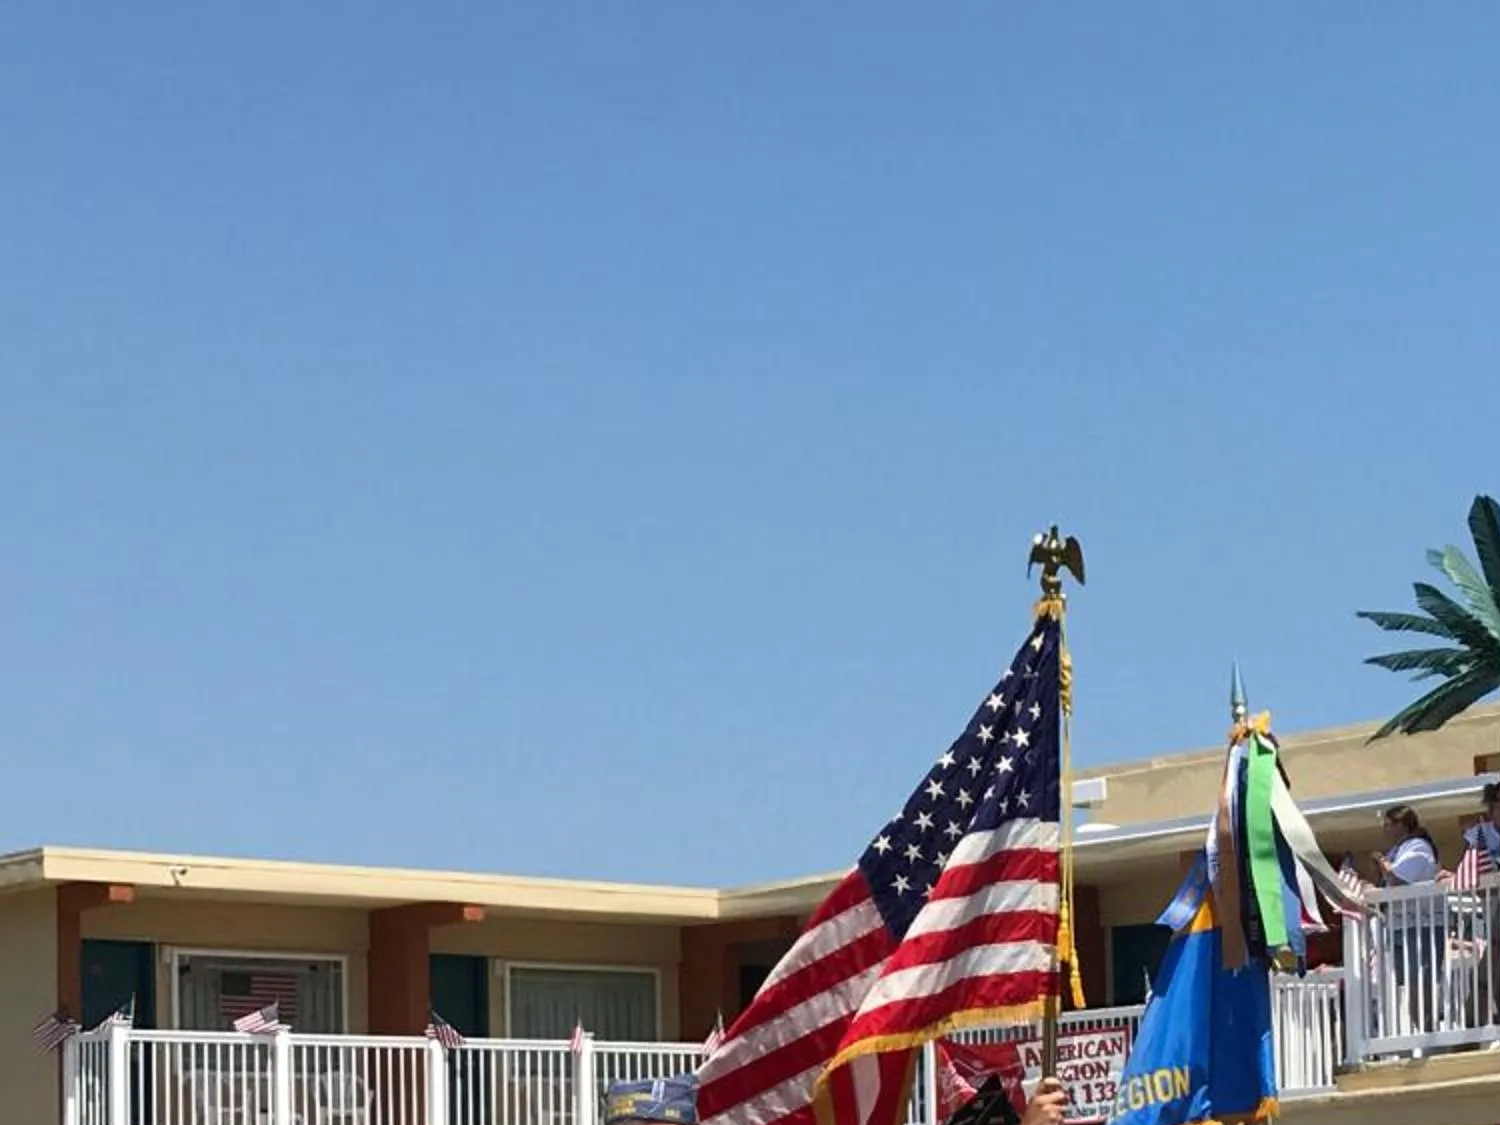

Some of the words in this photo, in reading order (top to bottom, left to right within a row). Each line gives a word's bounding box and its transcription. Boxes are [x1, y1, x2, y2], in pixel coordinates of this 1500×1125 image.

[1025, 1037, 1123, 1068] AERICAN
[1055, 1060, 1110, 1082] GION
[1082, 1081, 1117, 1104] 133
[1115, 1064, 1190, 1117] EGION
